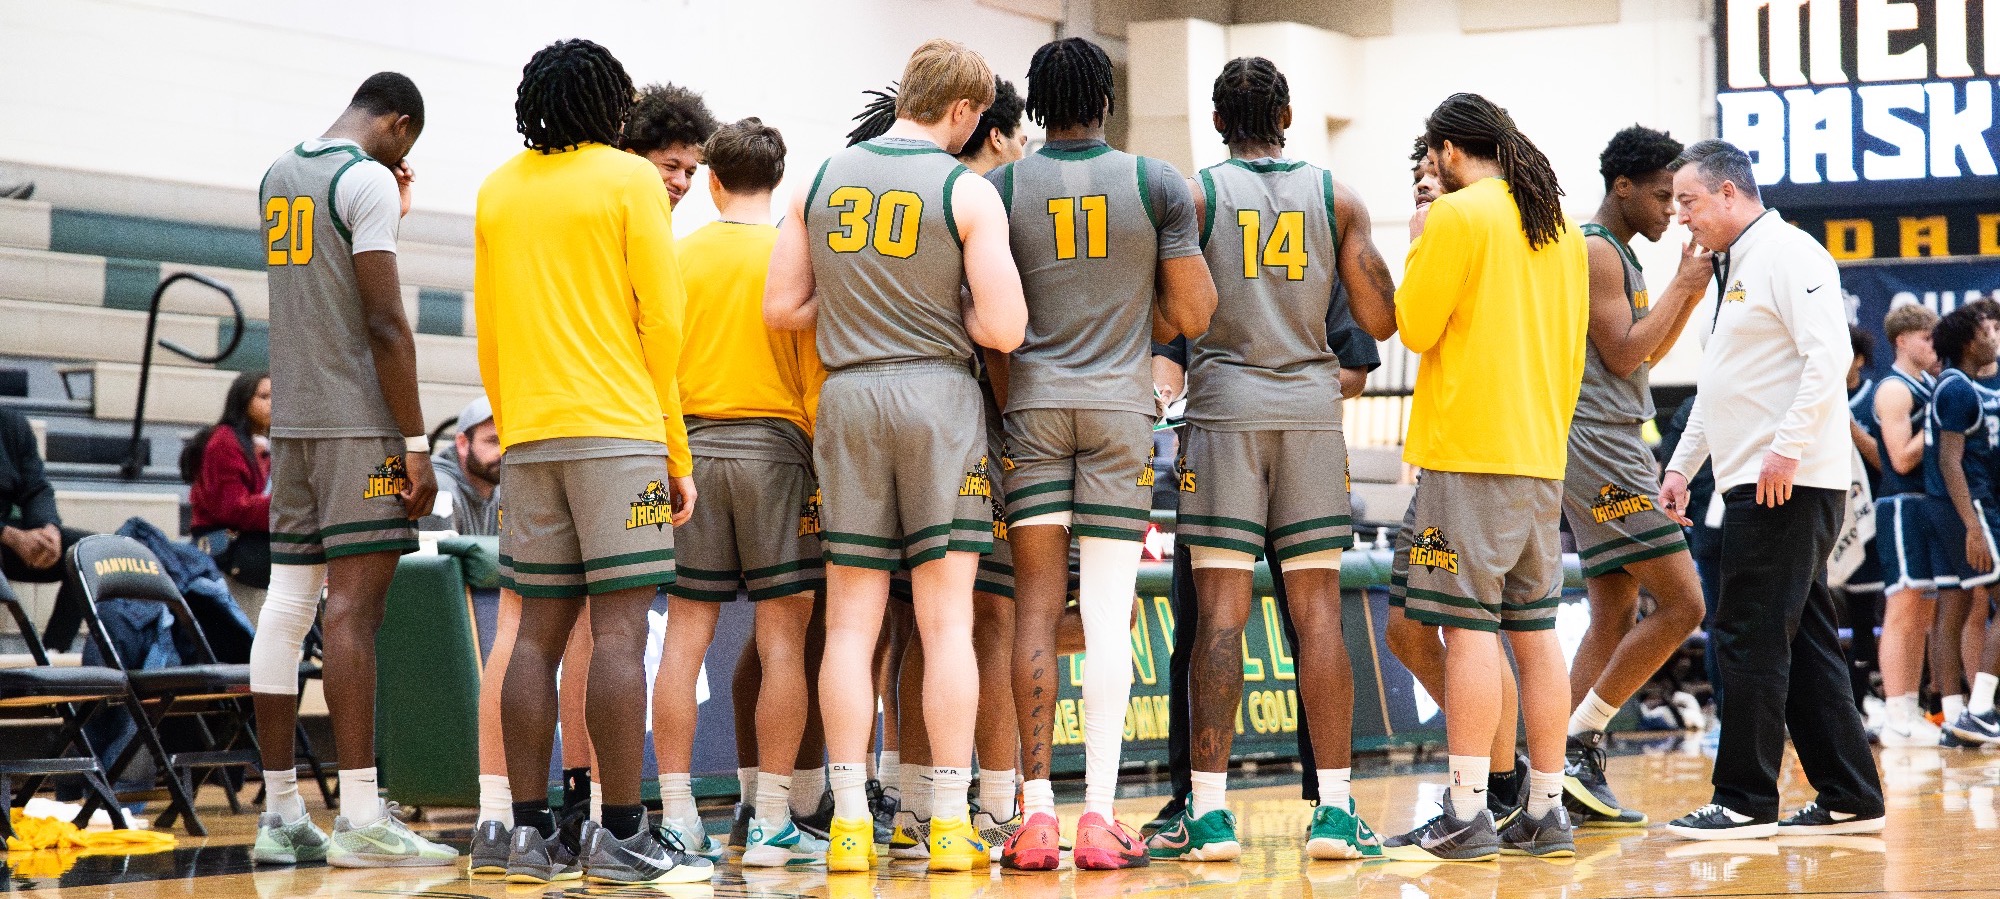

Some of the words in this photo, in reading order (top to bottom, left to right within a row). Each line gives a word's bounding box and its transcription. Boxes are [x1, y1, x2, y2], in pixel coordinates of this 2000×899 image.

[265, 195, 316, 267] 20
[826, 185, 924, 260] 30
[1046, 194, 1109, 260] 11
[1236, 208, 1309, 281] 14
[95, 557, 160, 577] DANVILLE
[1409, 546, 1459, 575] AGUARS
